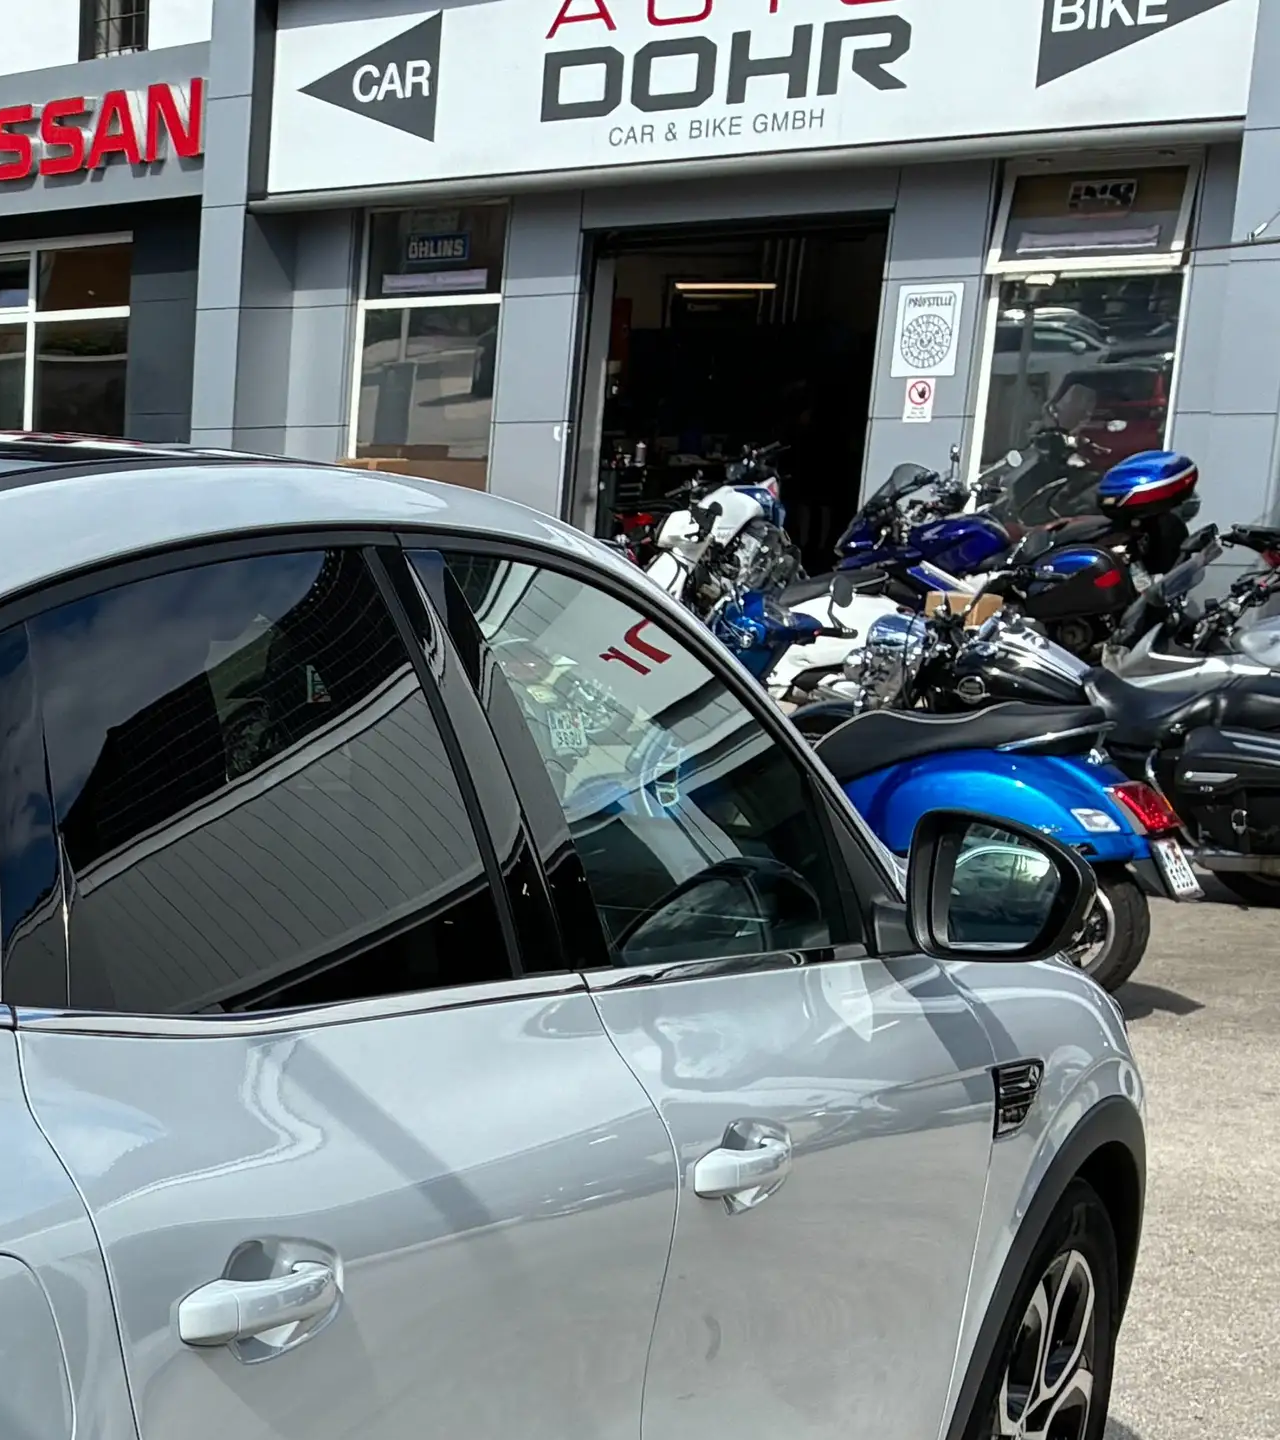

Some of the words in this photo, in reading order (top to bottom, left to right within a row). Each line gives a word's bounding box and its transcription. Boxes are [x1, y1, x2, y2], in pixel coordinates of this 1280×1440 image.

[1051, 0, 1168, 33] BIKE
[352, 62, 431, 104] CAR
[540, 15, 912, 122] DOHR
[608, 123, 655, 147] CAR
[665, 122, 678, 141] &
[689, 116, 743, 139] BIKE
[752, 108, 825, 133] GMBH
